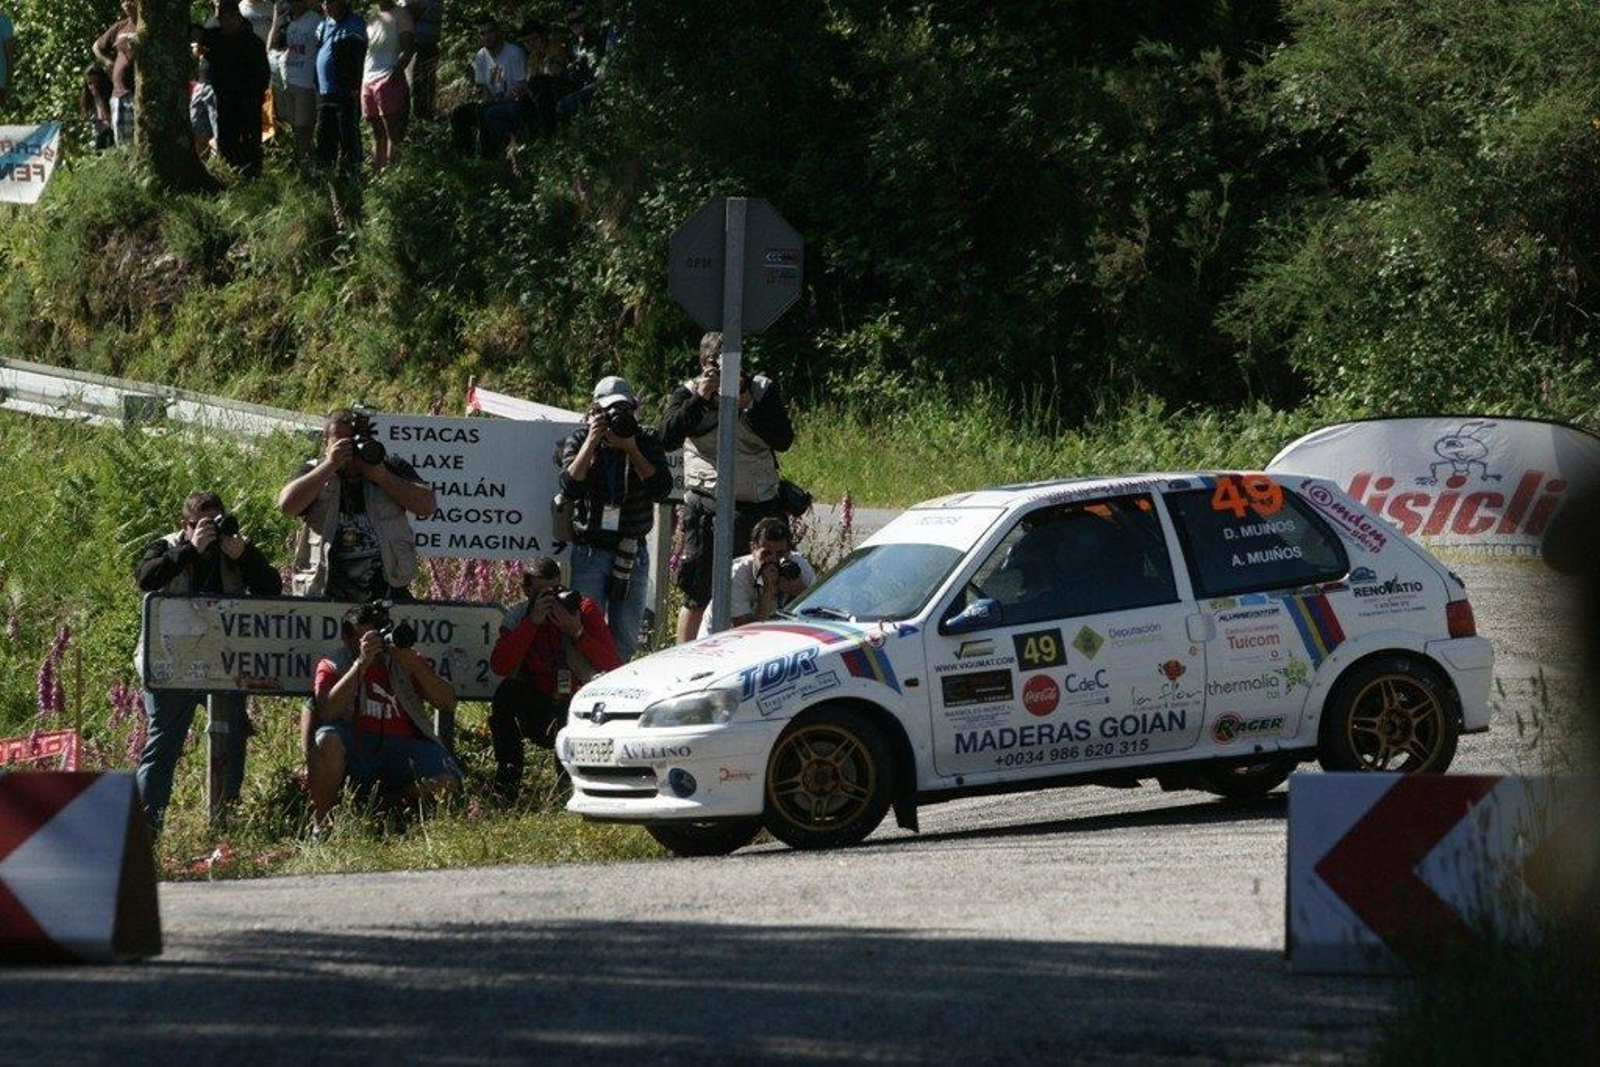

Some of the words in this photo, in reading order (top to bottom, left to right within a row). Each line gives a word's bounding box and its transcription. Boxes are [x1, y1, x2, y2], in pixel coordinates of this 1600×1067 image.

[389, 426, 480, 444] ESTACAS
[412, 453, 464, 470] LAXE
[424, 477, 506, 499] HALÁN
[1210, 474, 1284, 518] 49
[415, 532, 441, 548] DE
[449, 533, 541, 551] MAGINA
[1231, 554, 1246, 567] A.
[1247, 544, 1303, 564] MUIÑOS
[1353, 574, 1423, 598] RENOVATIO
[220, 608, 312, 640] VENTÍN
[322, 615, 345, 641] D
[480, 621, 491, 645] 1
[1022, 634, 1058, 664] 49
[220, 651, 312, 679] VENTÍN
[475, 658, 490, 683] 2
[740, 646, 819, 702] TDR
[1064, 669, 1109, 693] CdeC
[954, 719, 1091, 754] MADERAS
[620, 744, 692, 760] AVELINO
[994, 750, 1044, 767] +0034
[1049, 745, 1080, 761] 986
[1085, 741, 1114, 757] 620
[1121, 738, 1150, 754] 315
